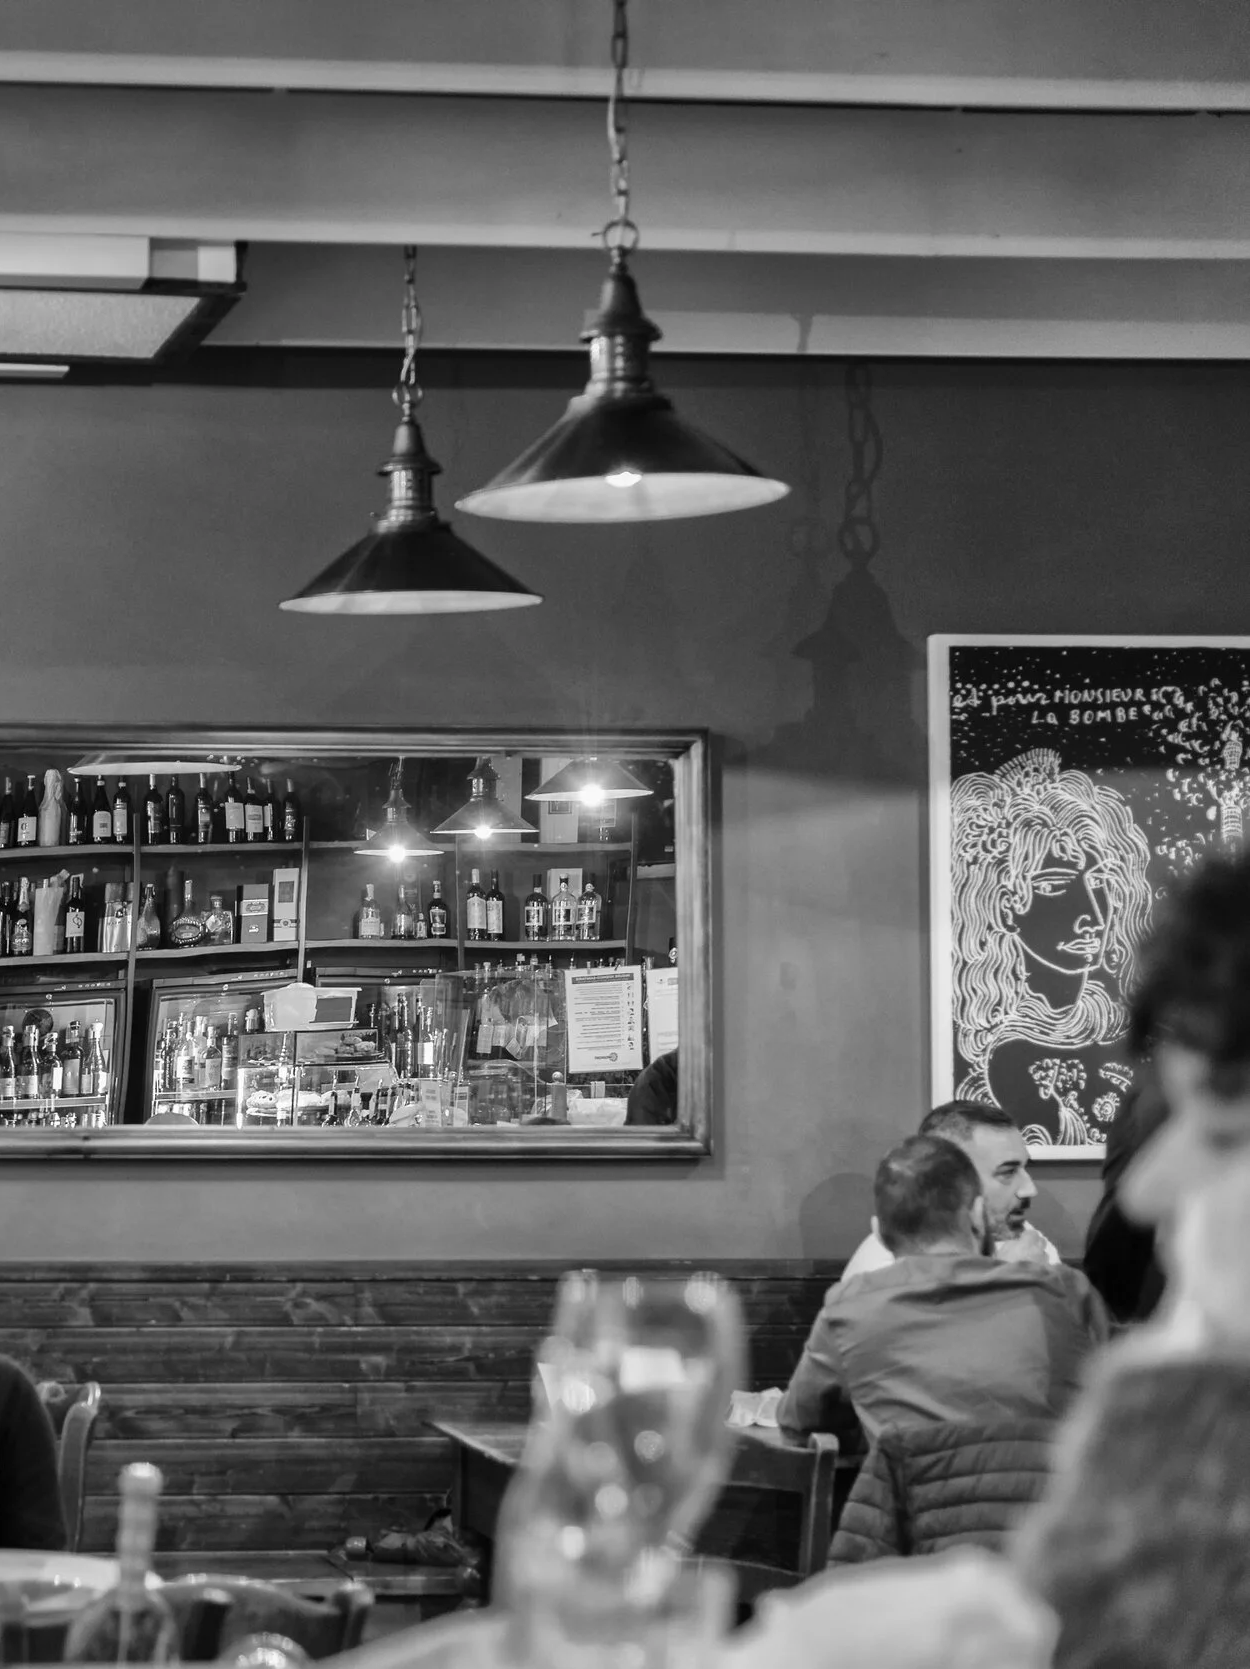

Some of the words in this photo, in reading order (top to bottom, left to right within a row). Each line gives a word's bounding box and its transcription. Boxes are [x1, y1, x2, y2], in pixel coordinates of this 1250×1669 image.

[991, 692, 1051, 716] pour
[1053, 687, 1147, 705] MONSIEUR
[1068, 706, 1139, 725] BOMBE
